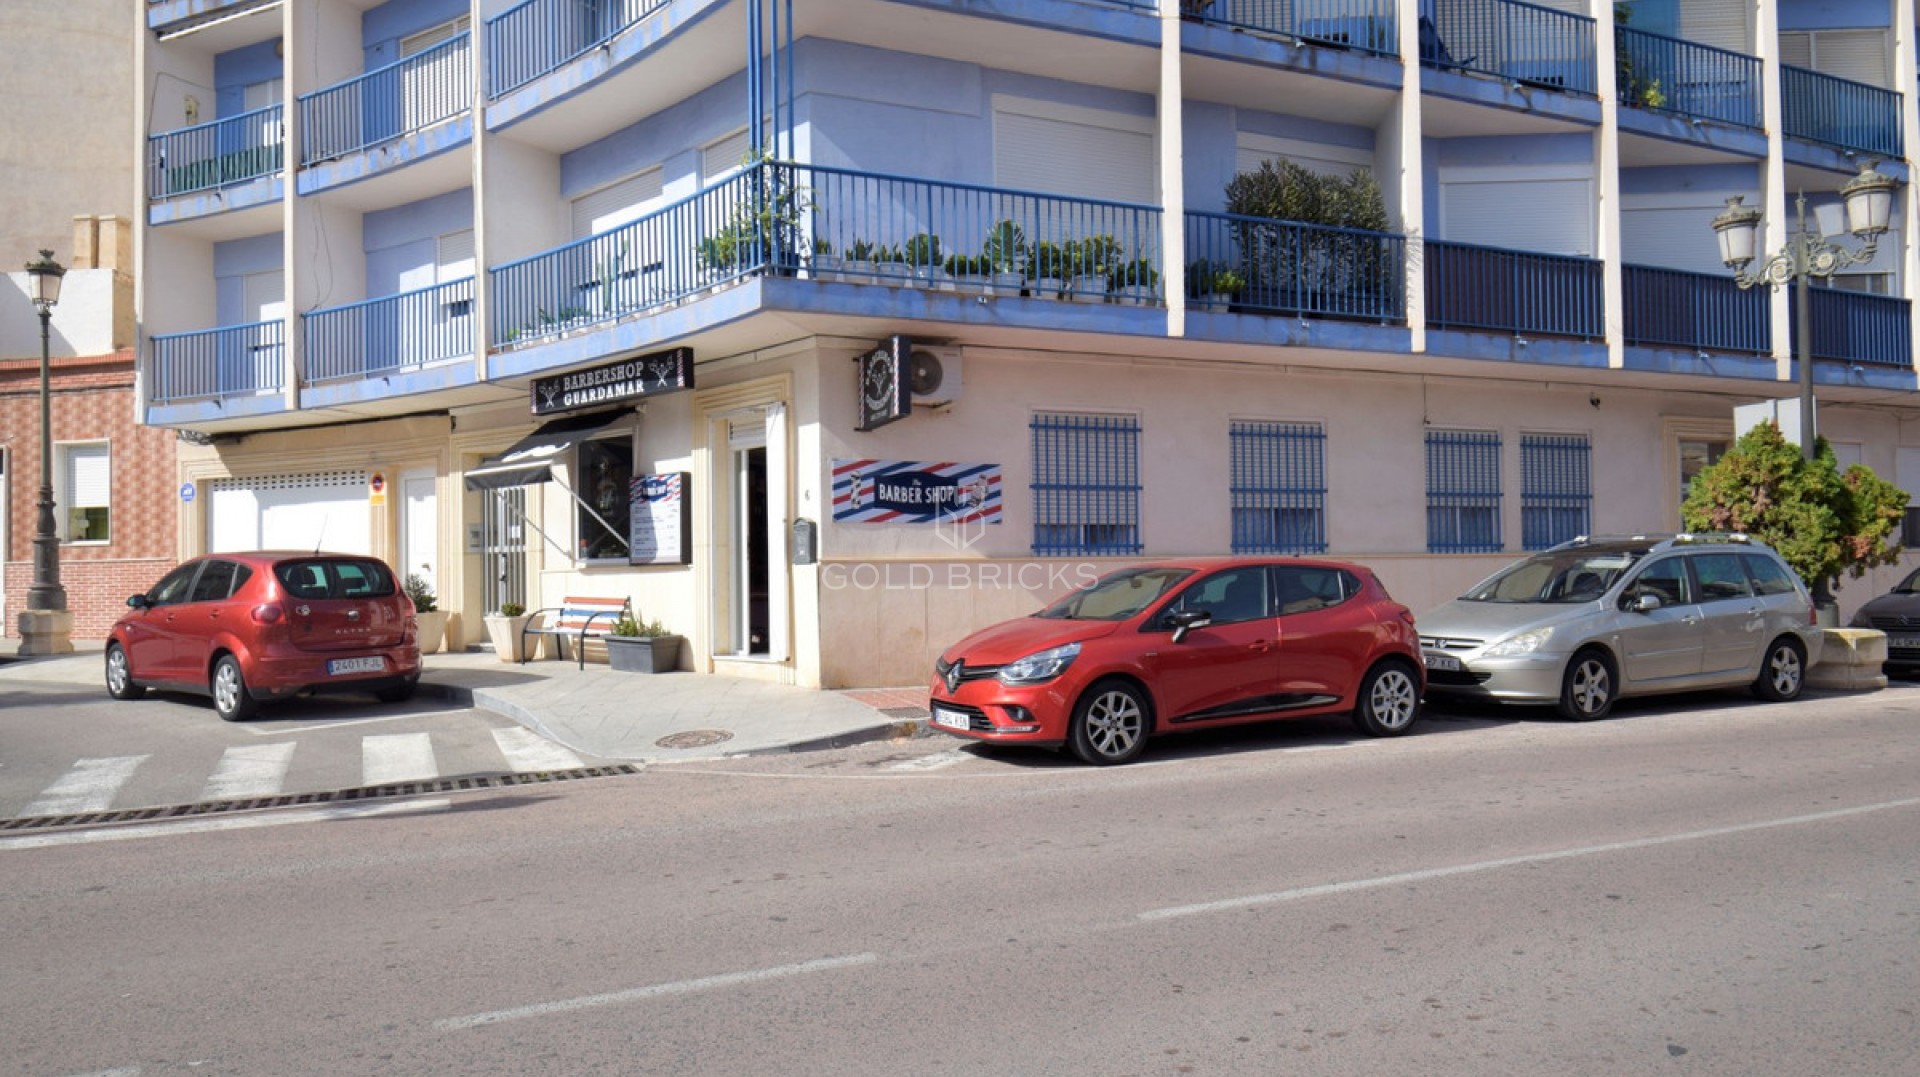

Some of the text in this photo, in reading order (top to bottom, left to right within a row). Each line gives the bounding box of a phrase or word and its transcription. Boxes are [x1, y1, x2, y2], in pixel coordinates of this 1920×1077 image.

[563, 361, 644, 391] BARBERSHOP
[563, 379, 645, 406] GUARDAMAR
[879, 484, 954, 503] BARBER SHOP
[335, 659, 361, 671] 2401
